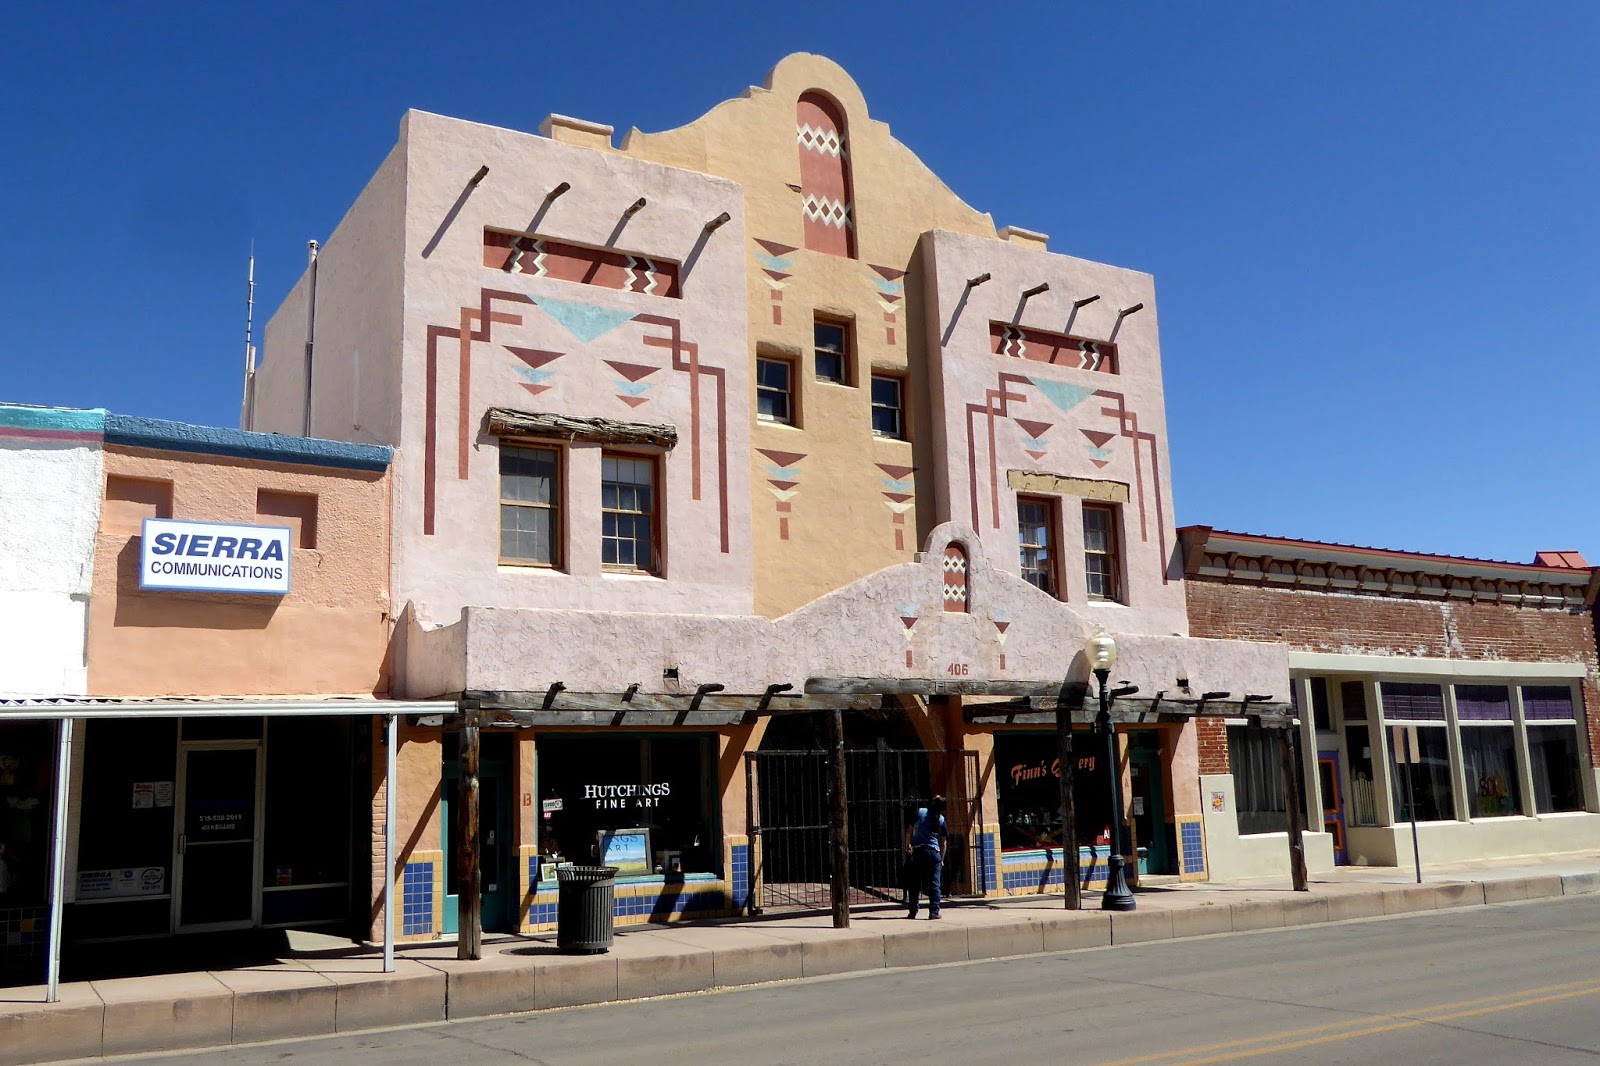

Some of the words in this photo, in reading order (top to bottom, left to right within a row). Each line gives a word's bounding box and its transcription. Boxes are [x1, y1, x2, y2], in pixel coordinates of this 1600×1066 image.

[152, 533, 283, 561] SIERRA
[151, 562, 283, 580] COMMUNICATIONS
[947, 663, 969, 675] 406
[1011, 760, 1047, 786] Finn's
[584, 783, 670, 799] HUTCHINGS
[596, 799, 626, 809] FINE
[636, 798, 660, 807] ART
